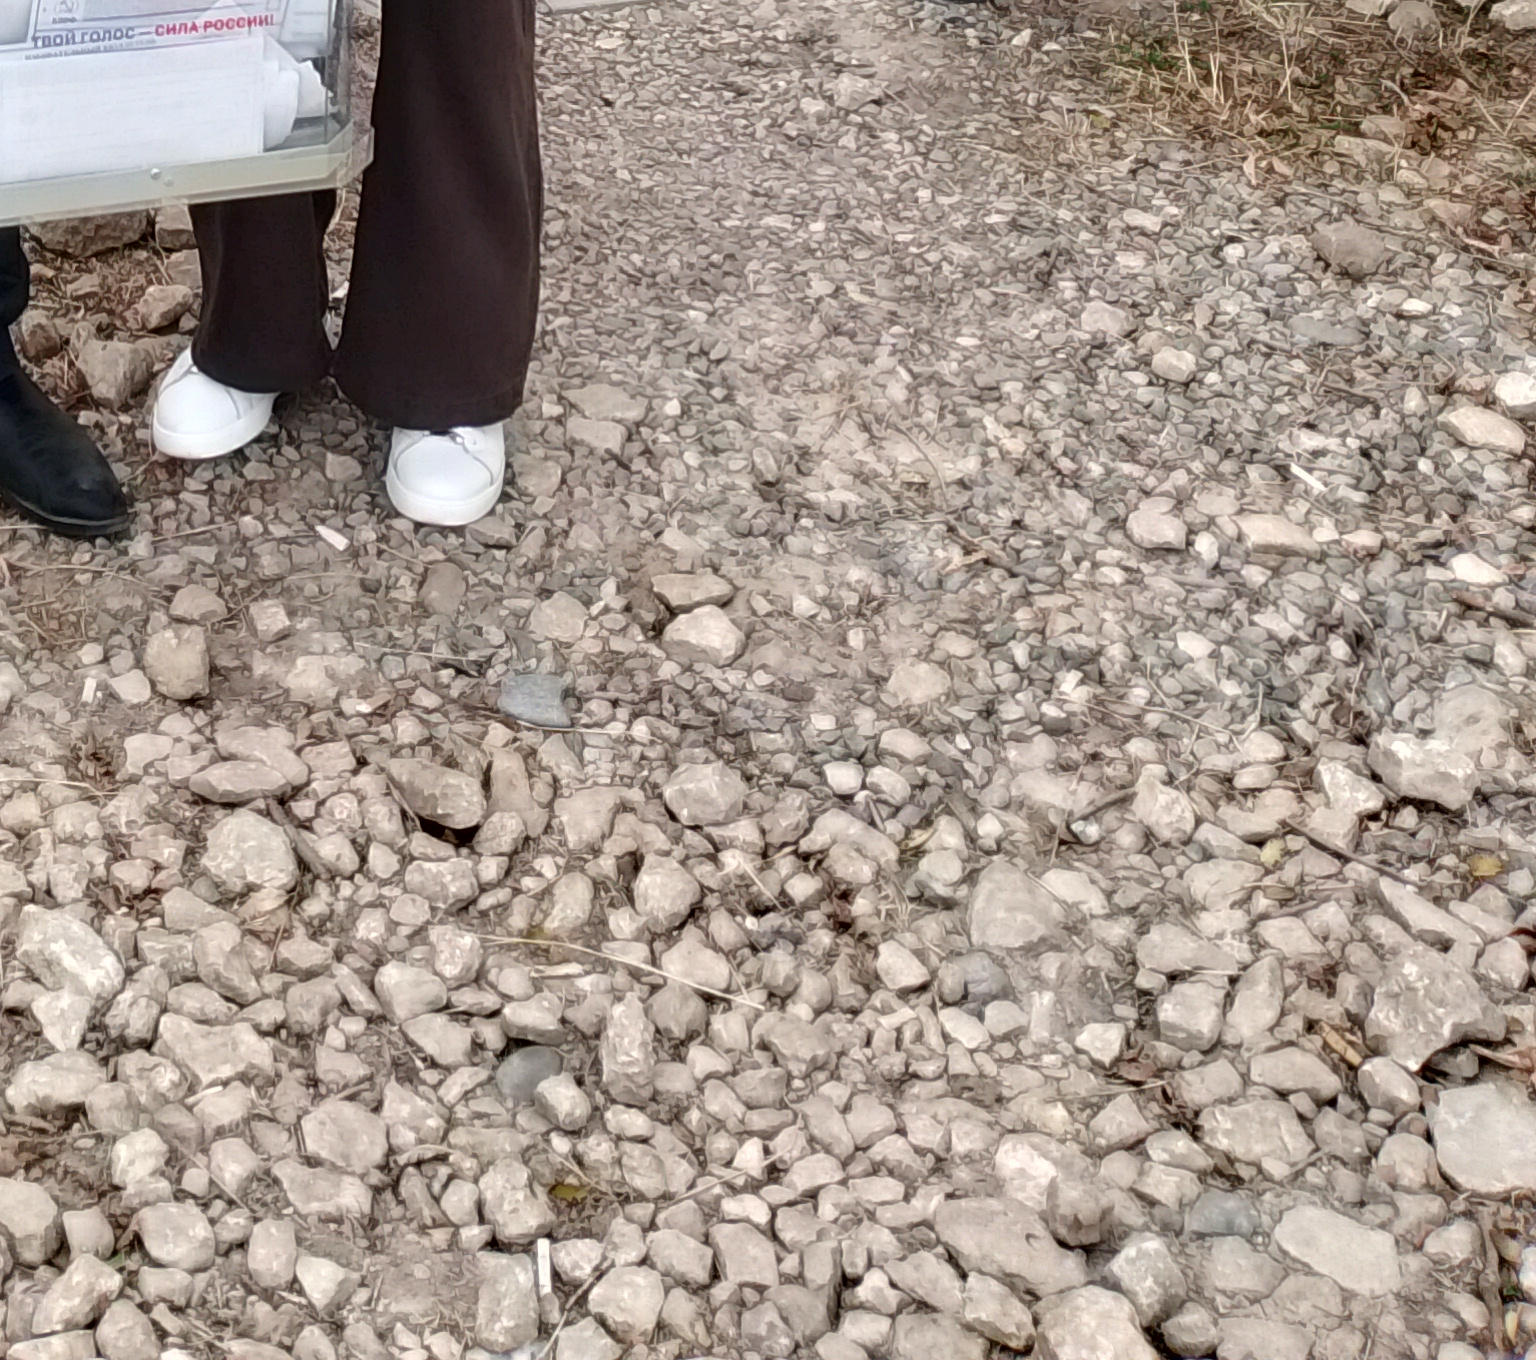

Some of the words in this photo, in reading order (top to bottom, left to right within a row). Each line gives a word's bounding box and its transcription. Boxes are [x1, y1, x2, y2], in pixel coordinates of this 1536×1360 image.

[81, 26, 135, 44] ГОЛОС
[155, 21, 199, 37] СИЛА
[204, 14, 275, 32] РОССИИ!
